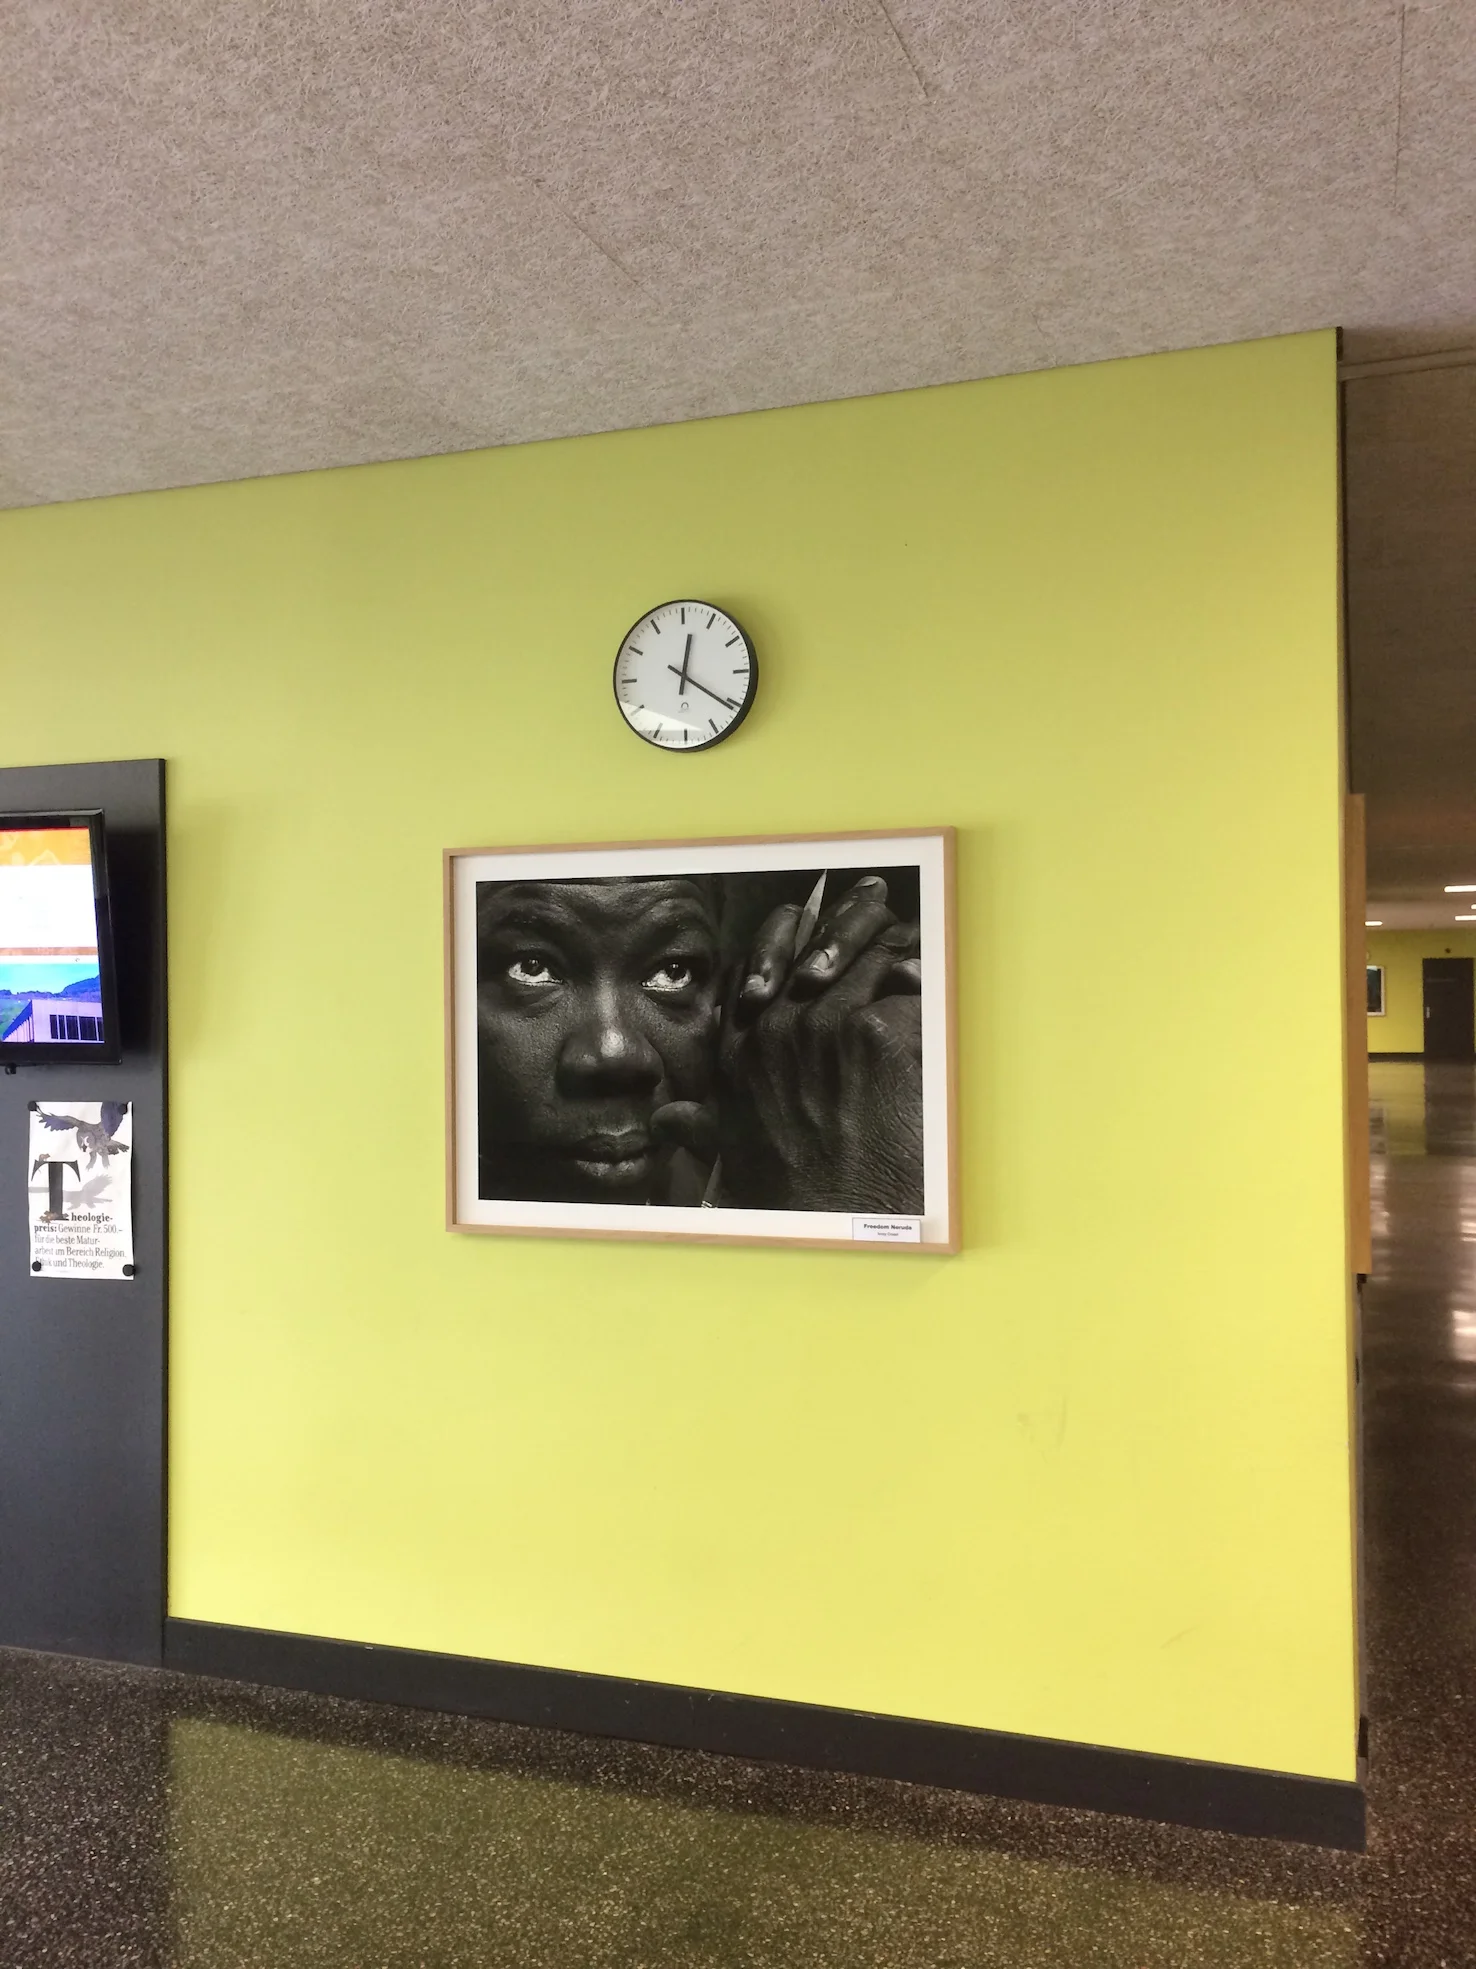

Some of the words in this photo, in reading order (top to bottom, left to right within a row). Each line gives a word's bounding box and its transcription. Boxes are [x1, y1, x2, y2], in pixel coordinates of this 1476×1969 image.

[34, 1224, 57, 1233] preis:
[58, 1224, 91, 1233] Gewinne
[93, 1224, 102, 1233] Fr.
[34, 1233, 45, 1243] für
[55, 1235, 75, 1245] beste
[76, 1235, 101, 1245] Matur-
[34, 1245, 54, 1255] arbeit
[55, 1246, 65, 1255] im
[66, 1246, 94, 1256] Bereich
[53, 1258, 67, 1267] und
[68, 1258, 105, 1270] Theologie.
